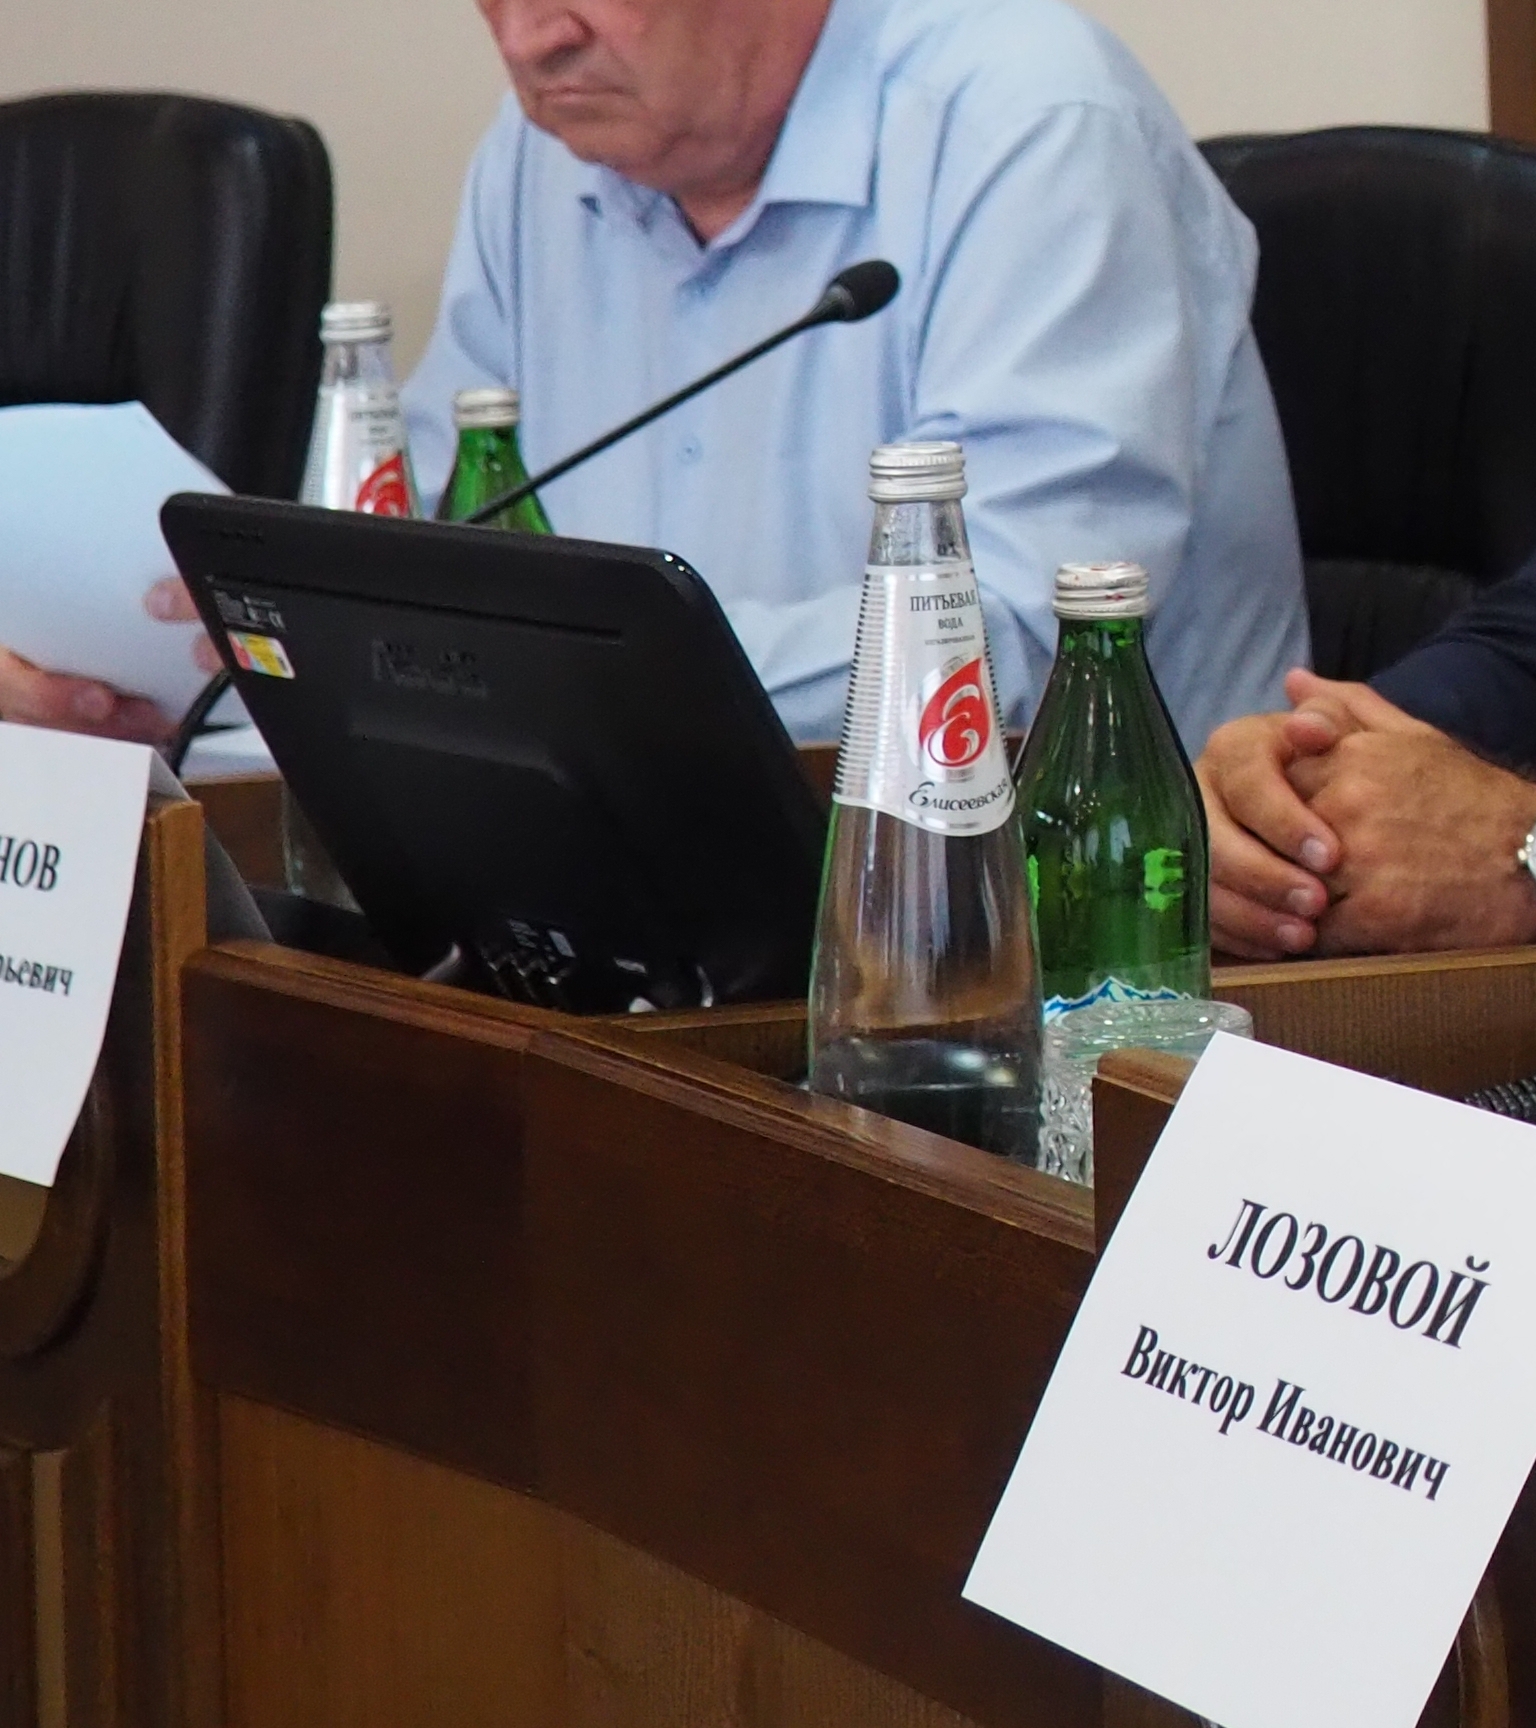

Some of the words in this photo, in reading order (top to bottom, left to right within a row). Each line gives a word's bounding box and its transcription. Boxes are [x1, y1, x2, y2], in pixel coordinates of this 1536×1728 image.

[1207, 1198, 1491, 1350] ЛОЗОВОЙ
[1121, 1324, 1255, 1436] Виктор
[1256, 1378, 1452, 1502] Иванович
